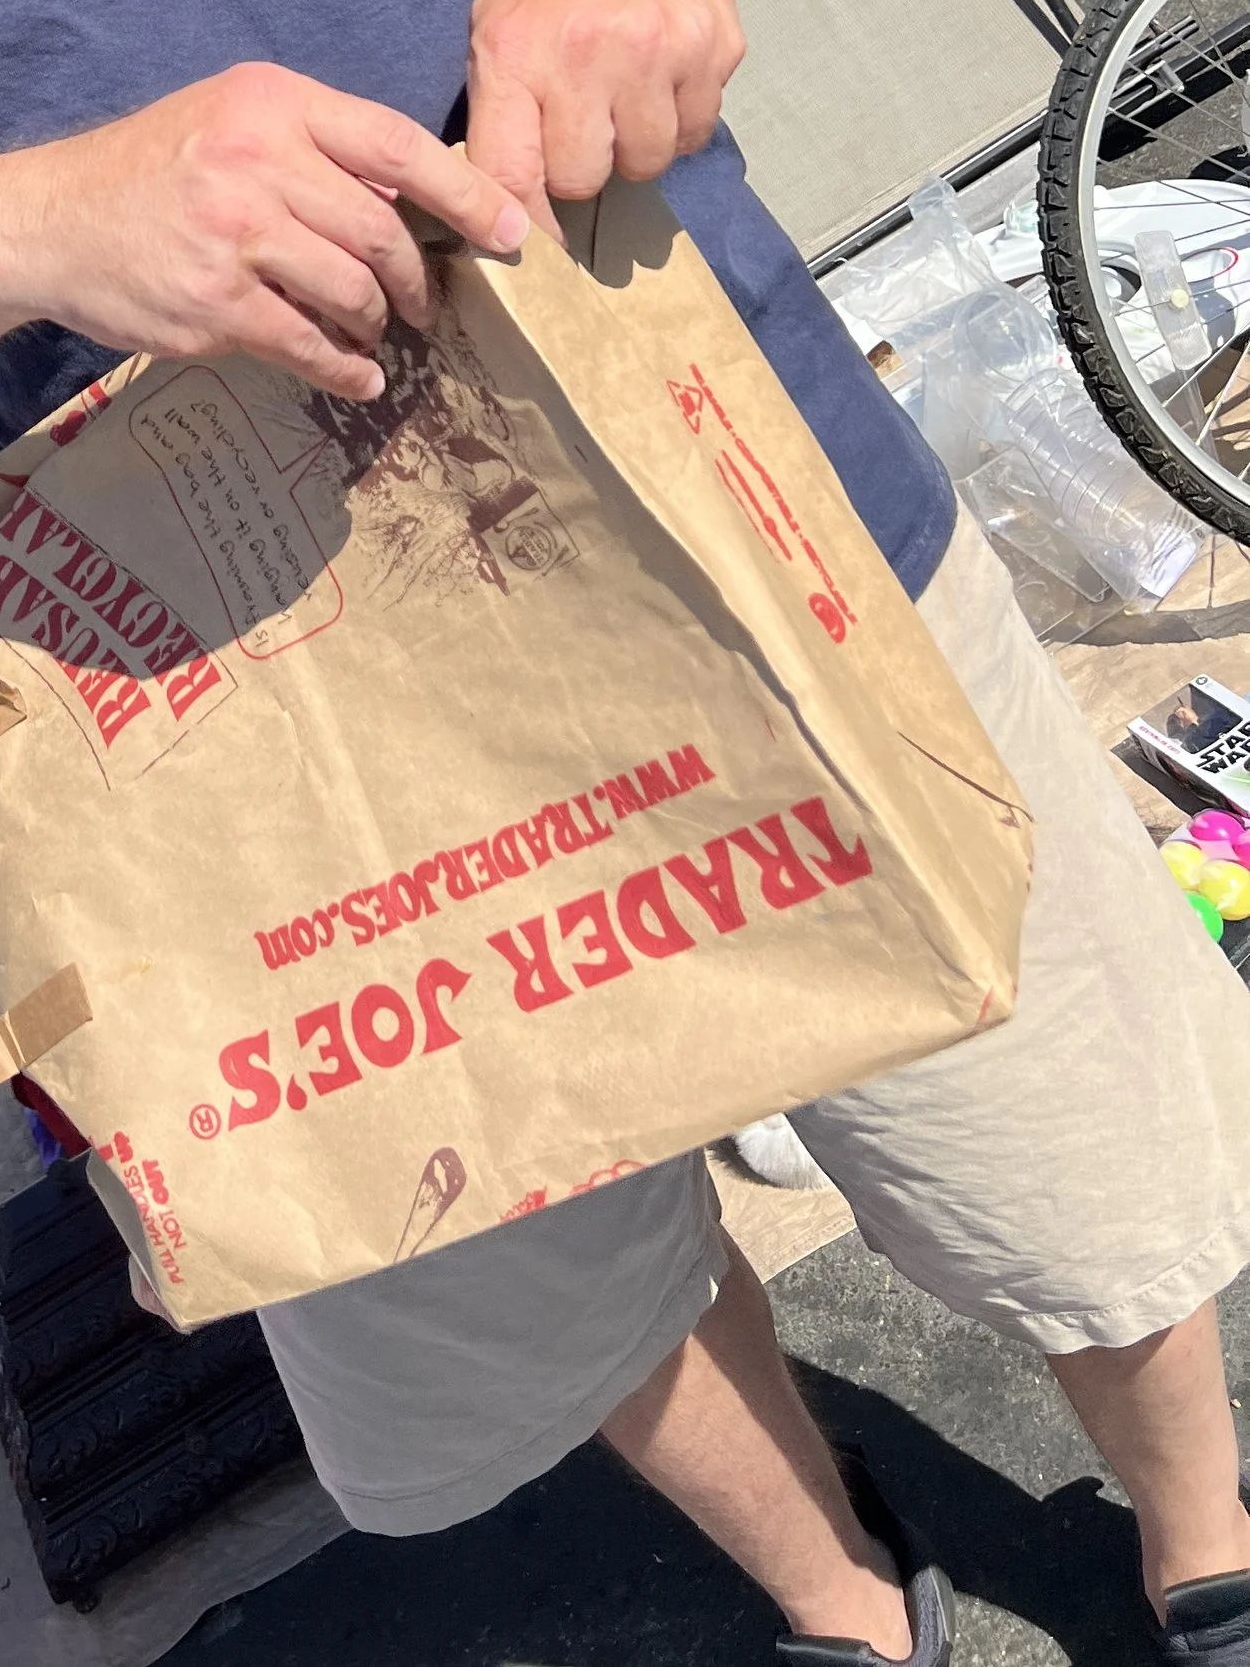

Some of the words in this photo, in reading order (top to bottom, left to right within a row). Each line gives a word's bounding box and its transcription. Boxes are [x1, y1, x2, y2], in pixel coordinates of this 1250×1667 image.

[140, 413, 174, 451] and
[164, 407, 201, 445] wall
[175, 451, 201, 499] bag
[200, 446, 227, 487] the
[197, 498, 221, 540] the
[225, 489, 240, 512] on
[260, 499, 275, 520] or
[235, 518, 251, 540] it
[249, 538, 293, 625] hanging
[273, 524, 313, 602] reusing
[218, 540, 261, 628] framing
[254, 630, 269, 649] Is
[485, 796, 874, 1014] TRADER
[141, 1158, 170, 1205] OUT
[124, 1165, 166, 1246] HANDLES
[159, 1209, 188, 1250] NOT
[159, 1248, 186, 1285] PULL
